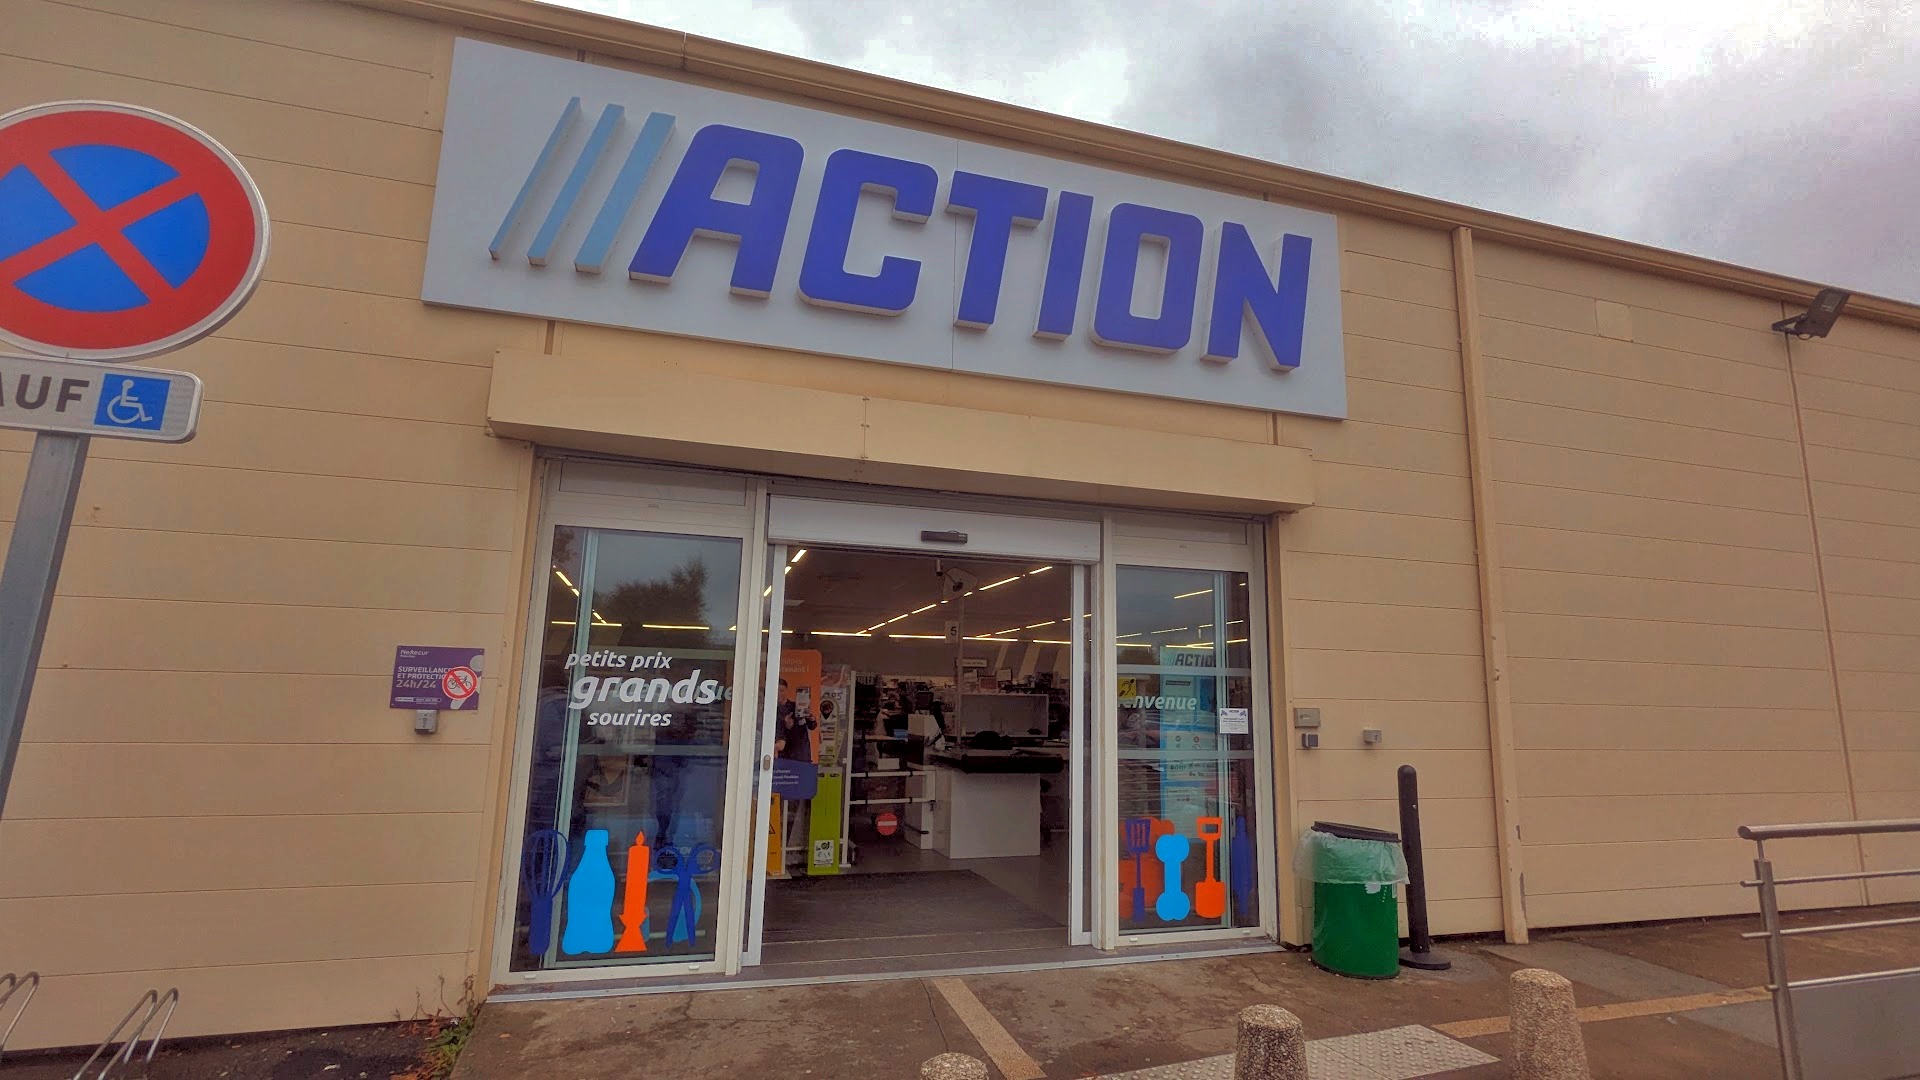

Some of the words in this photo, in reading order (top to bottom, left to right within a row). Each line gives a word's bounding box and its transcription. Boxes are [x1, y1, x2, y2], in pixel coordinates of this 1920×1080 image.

[628, 123, 1312, 372] ACTION
[0, 371, 90, 413] UF
[950, 625, 957, 636] 5
[564, 650, 627, 670] petits
[630, 651, 673, 671] prix
[1175, 653, 1215, 668] ACTIO
[396, 680, 437, 689] 24h/24
[569, 669, 719, 710] grands
[587, 708, 673, 727] sourires
